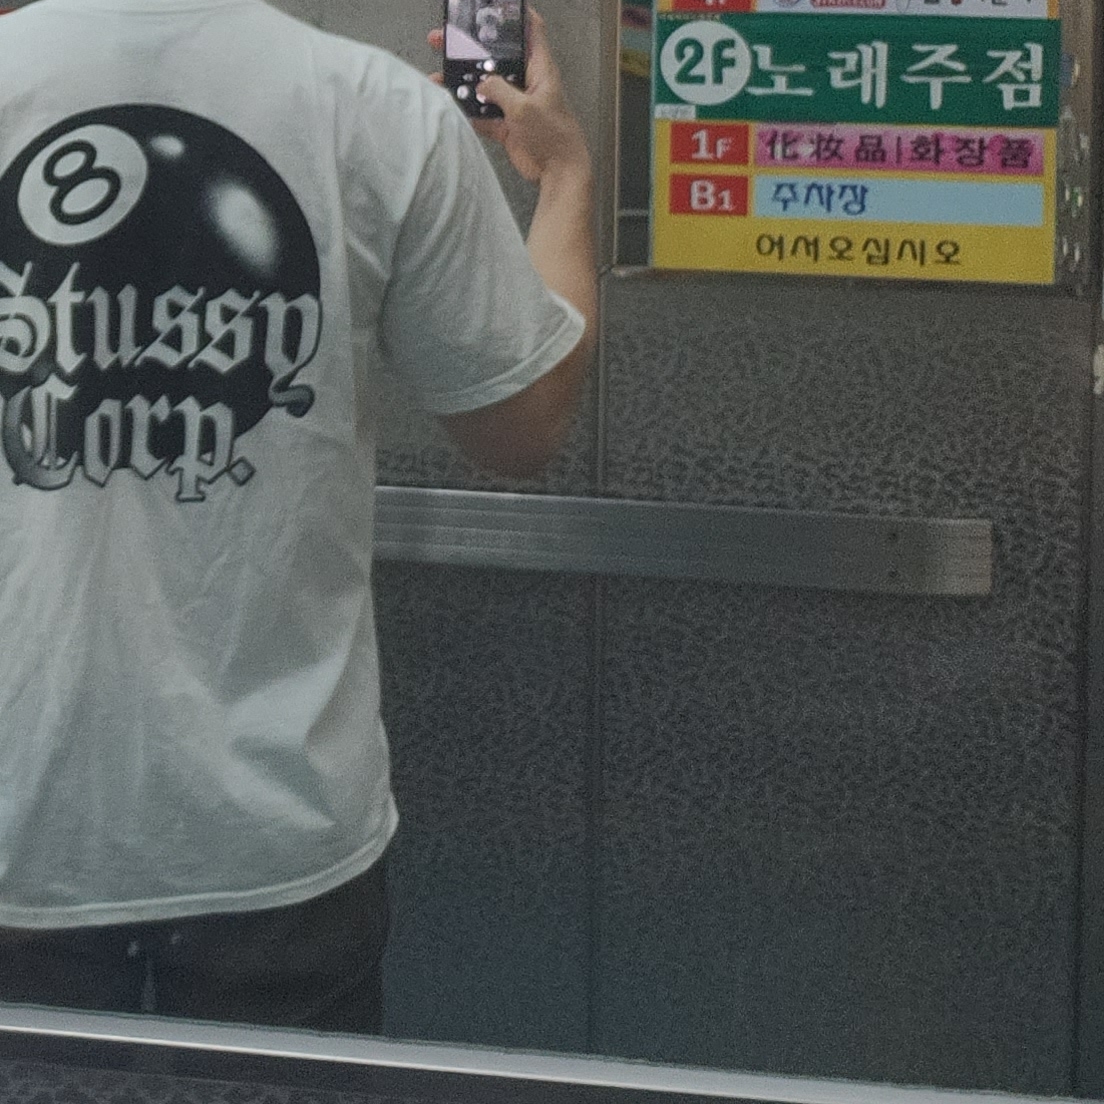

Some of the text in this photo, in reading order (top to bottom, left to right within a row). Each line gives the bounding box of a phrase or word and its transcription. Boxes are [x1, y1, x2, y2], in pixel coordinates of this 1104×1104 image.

[674, 37, 736, 85] 2F
[747, 40, 1044, 111] 노래주점
[692, 128, 733, 161] 1F
[910, 133, 1034, 169] 화장품
[42, 138, 122, 226] 8
[690, 180, 734, 211] B1
[756, 233, 961, 267] 어서오십시오
[1, 372, 257, 503] Corp.
